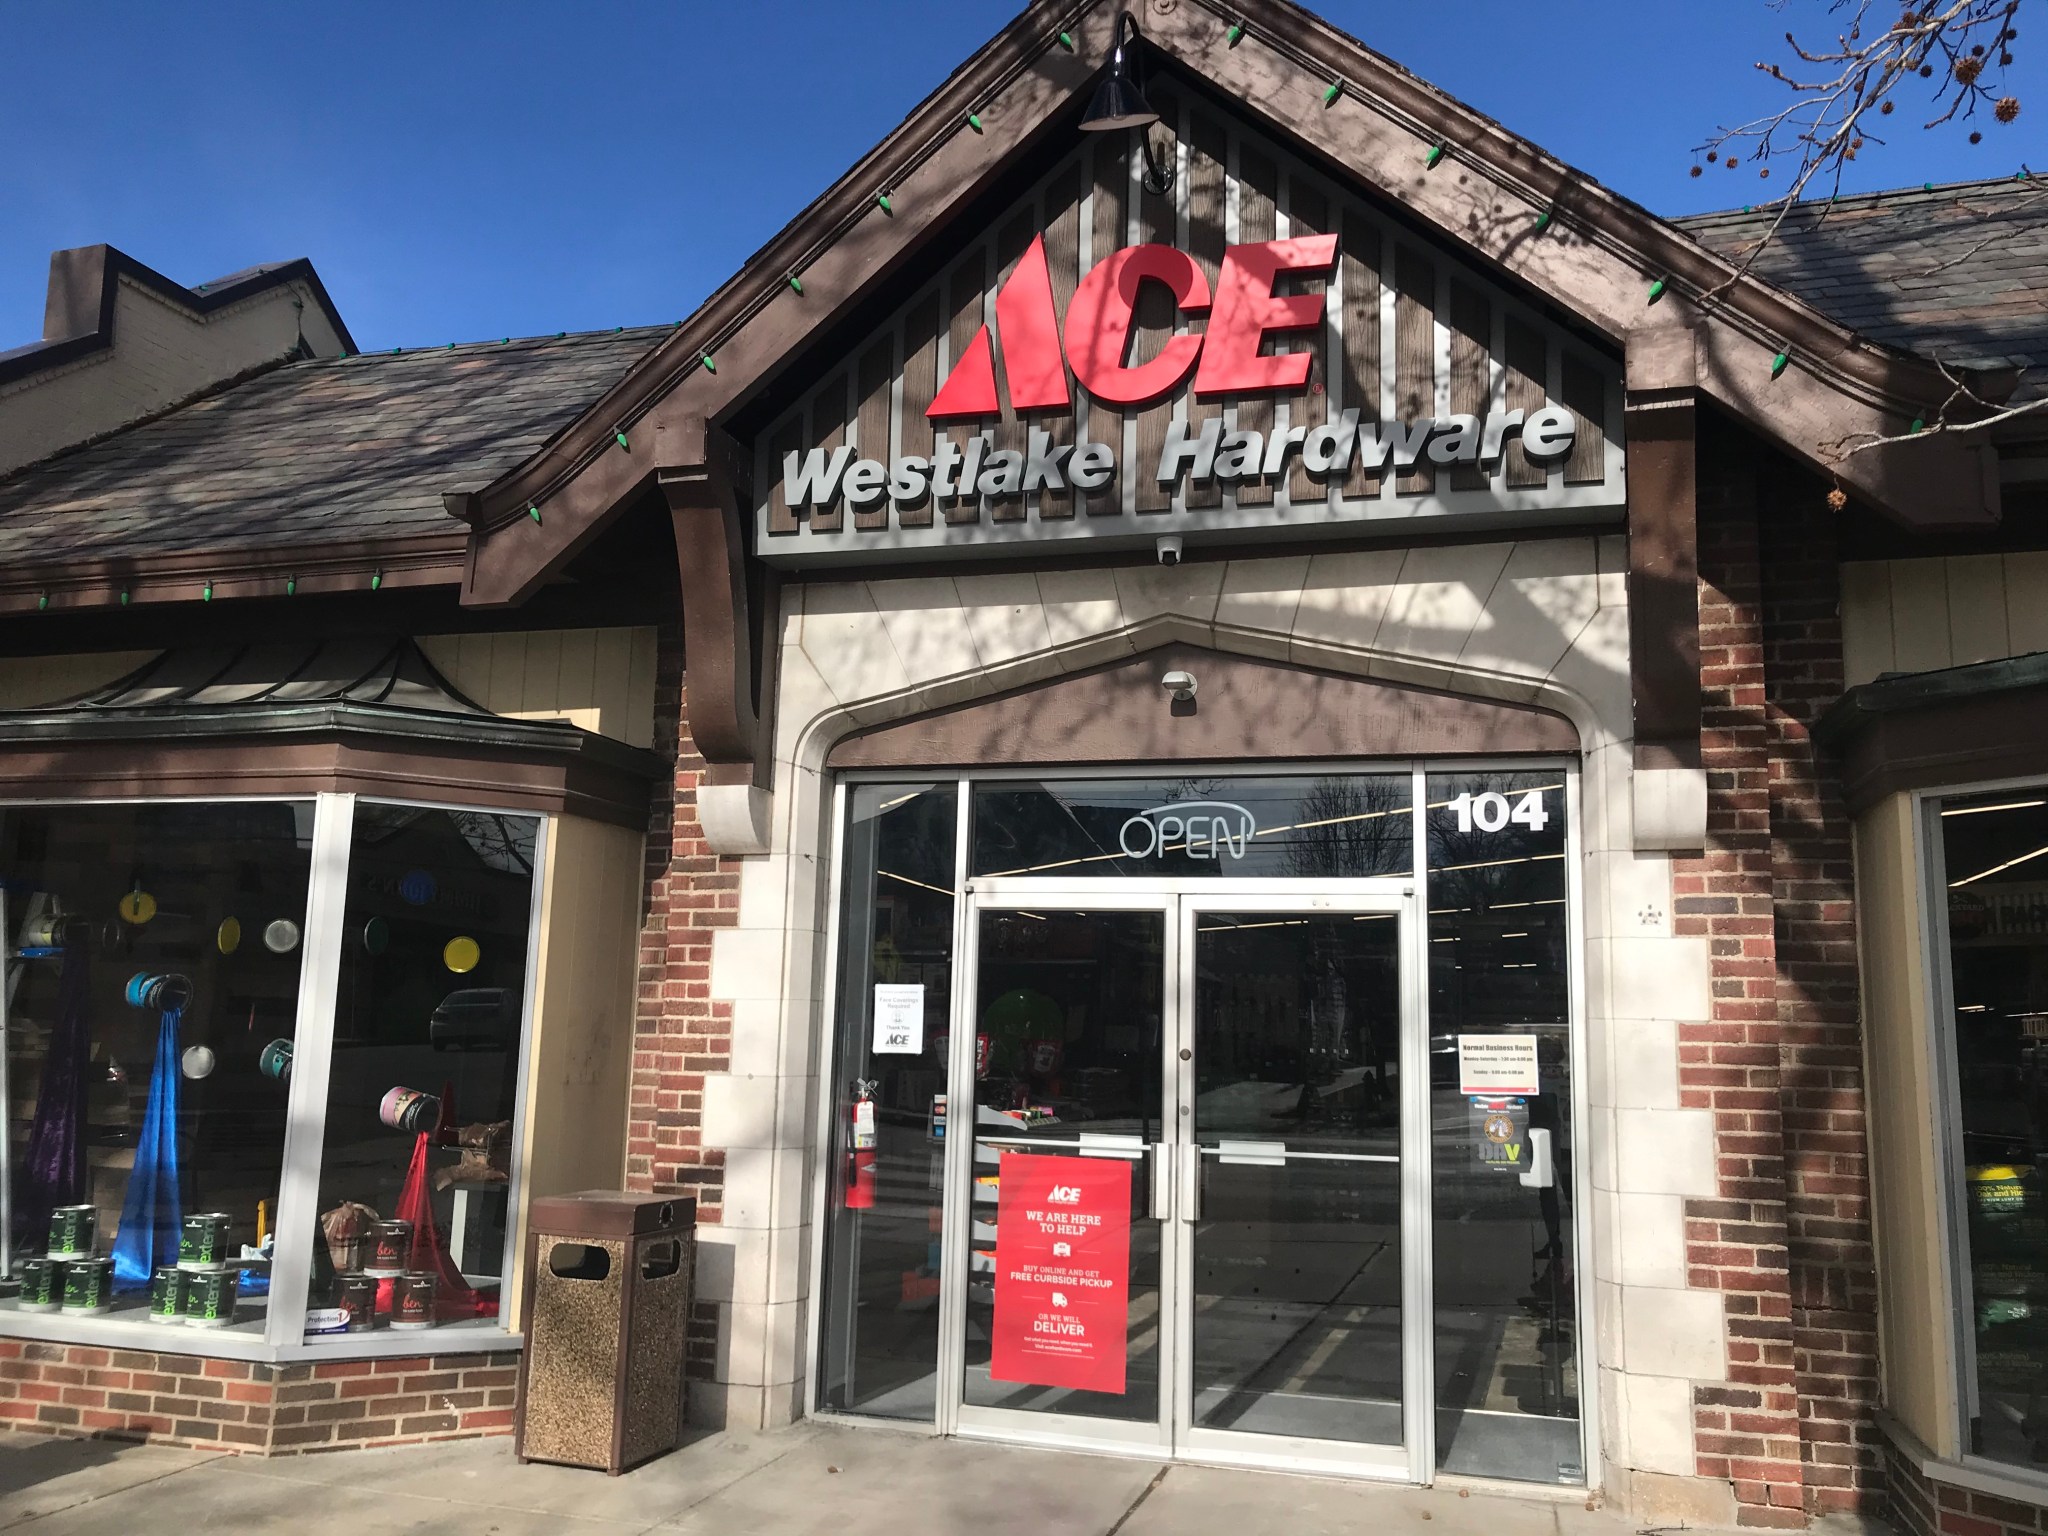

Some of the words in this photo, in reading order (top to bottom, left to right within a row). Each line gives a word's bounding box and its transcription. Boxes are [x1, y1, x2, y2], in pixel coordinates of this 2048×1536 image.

[925, 230, 1341, 417] ACE
[782, 435, 1117, 509] Westlake
[1155, 402, 1577, 485] Hardware
[1448, 790, 1549, 834] 104
[1119, 814, 1248, 860] OPEN
[885, 1033, 910, 1045] ACE
[1047, 1184, 1081, 1202] ACE
[1026, 1210, 1044, 1221] WE
[1046, 1212, 1068, 1223] ARE
[1071, 1214, 1101, 1226] HERE
[1040, 1222, 1055, 1233] TO
[1057, 1224, 1086, 1236] HELP
[1010, 1271, 1032, 1281] FREE
[1034, 1273, 1078, 1286] CURBSIDE
[1079, 1277, 1113, 1288] PICKUP
[1023, 1264, 1038, 1273] BUY
[1040, 1266, 1067, 1275] ONLINE
[1068, 1268, 1084, 1276] AND
[1085, 1269, 1100, 1278] GET
[1038, 1313, 1049, 1321] OR
[1050, 1314, 1061, 1322] WE
[1063, 1315, 1081, 1324] WILL
[1033, 1320, 1085, 1337] DELIVER
